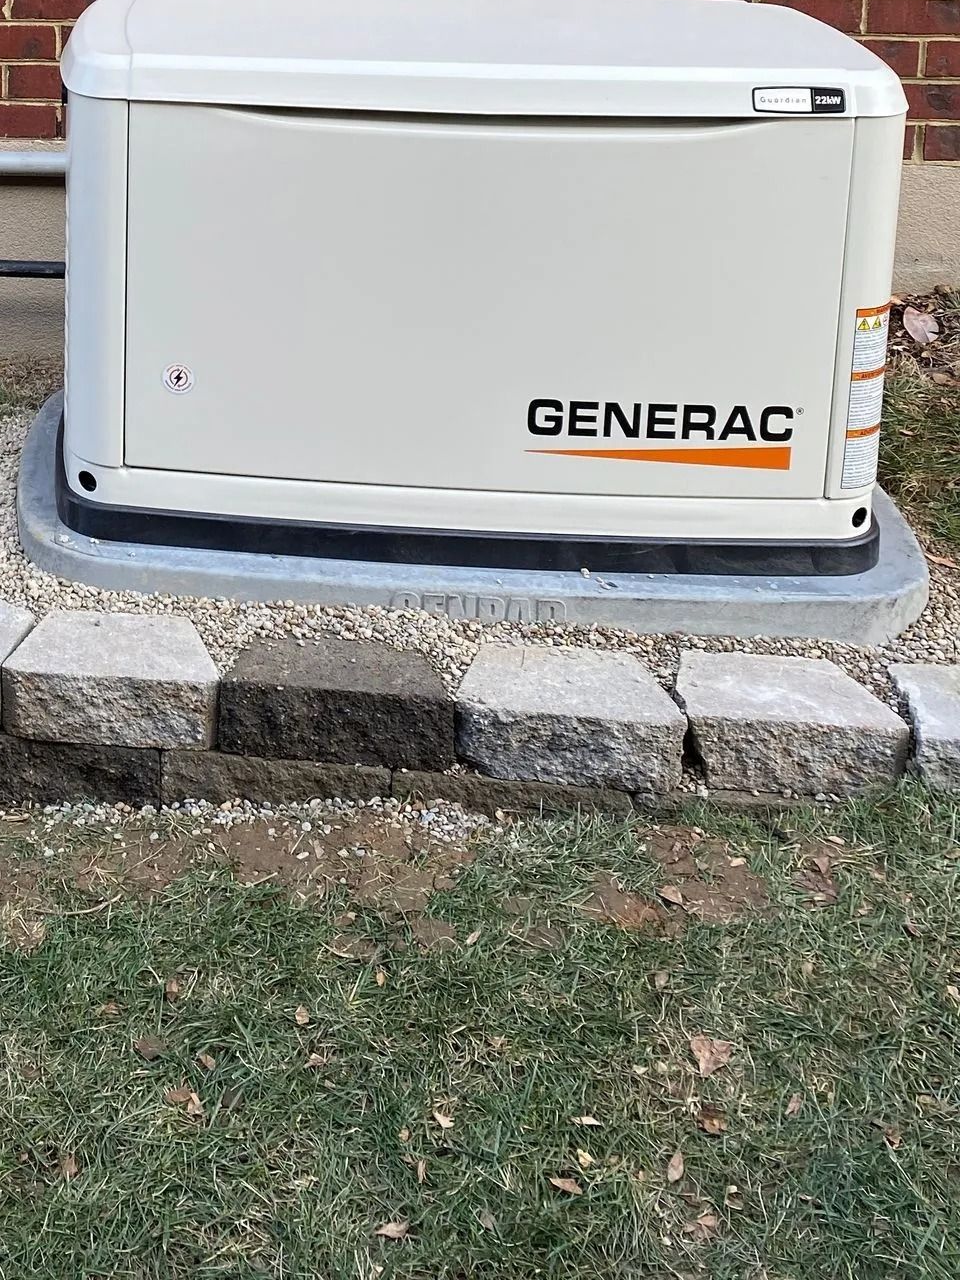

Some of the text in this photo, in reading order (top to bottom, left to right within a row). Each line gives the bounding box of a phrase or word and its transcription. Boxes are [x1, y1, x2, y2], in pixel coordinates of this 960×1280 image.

[759, 95, 842, 105] Guardian 22kW
[527, 398, 794, 442] GENERAC
